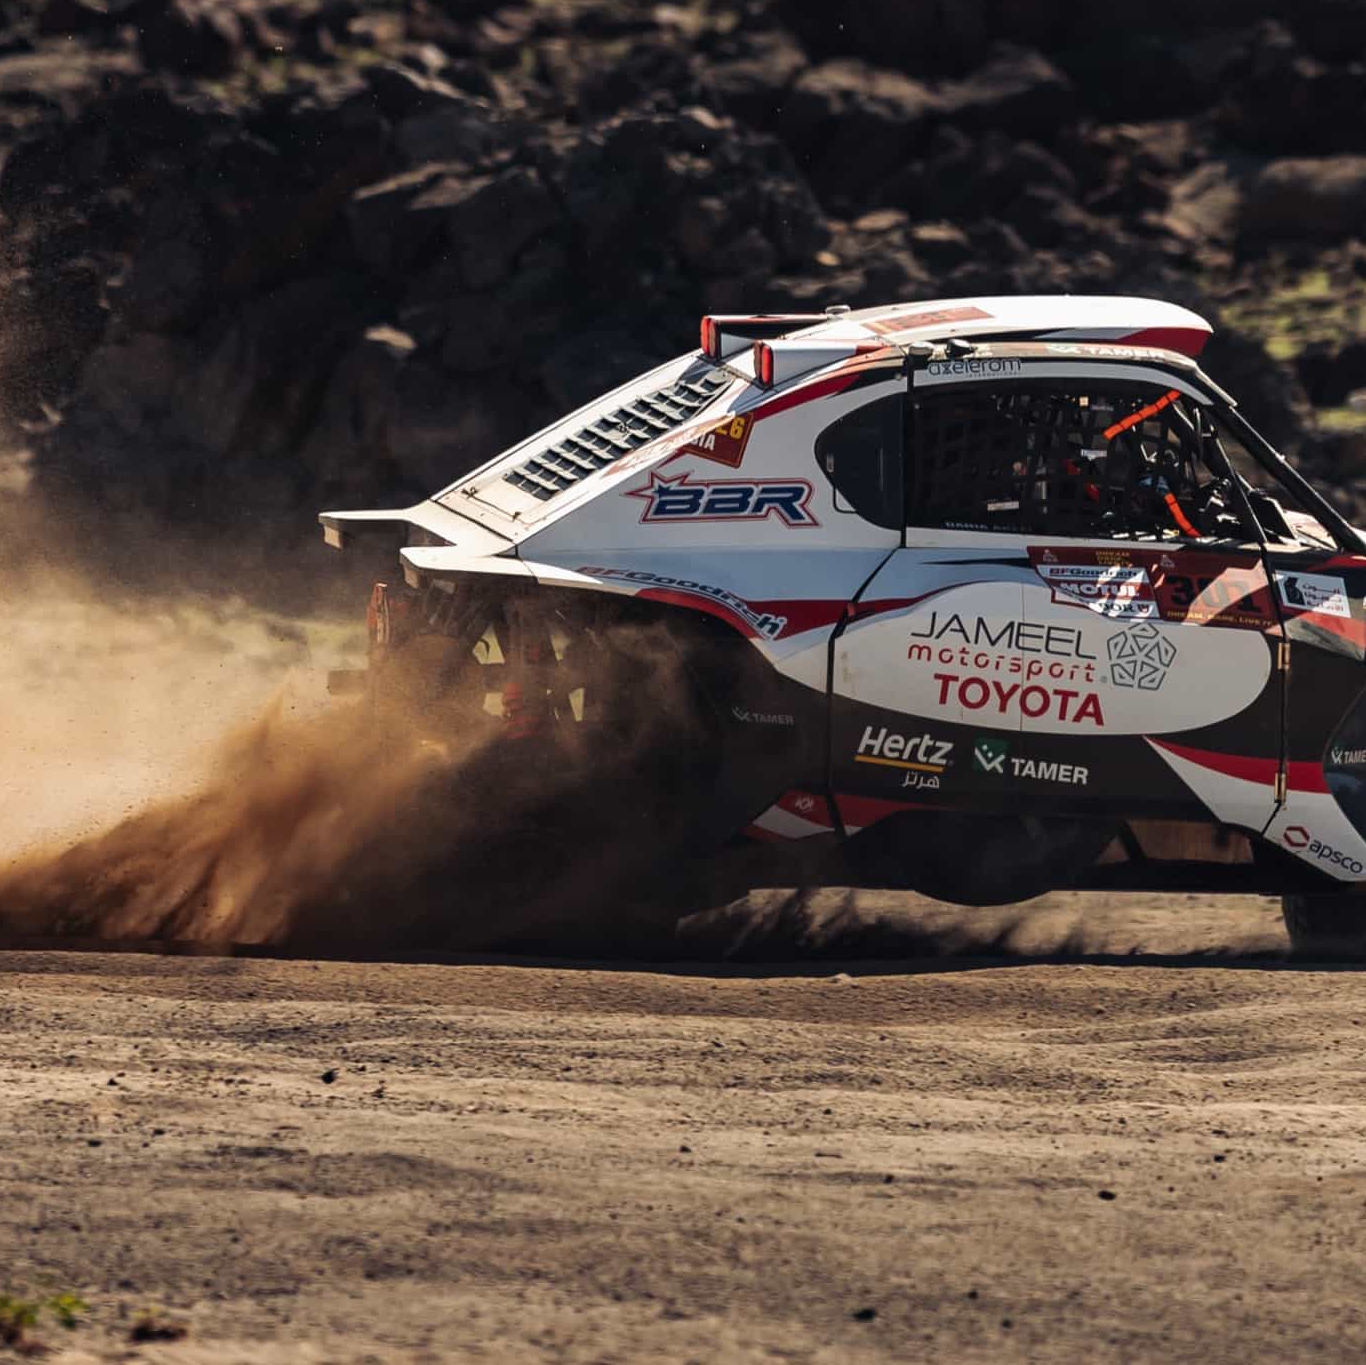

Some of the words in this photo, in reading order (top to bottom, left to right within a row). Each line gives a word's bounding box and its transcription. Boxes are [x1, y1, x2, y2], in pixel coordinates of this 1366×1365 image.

[652, 486, 807, 522] BBR
[1059, 582, 1137, 598] MOTUL
[910, 611, 1097, 660] JAMEEL
[907, 643, 1095, 683] motorsport
[933, 673, 1105, 727] TOYOTA
[856, 726, 954, 765] Hertz
[1011, 757, 1089, 785] TAMER
[1308, 839, 1364, 875] apsco
